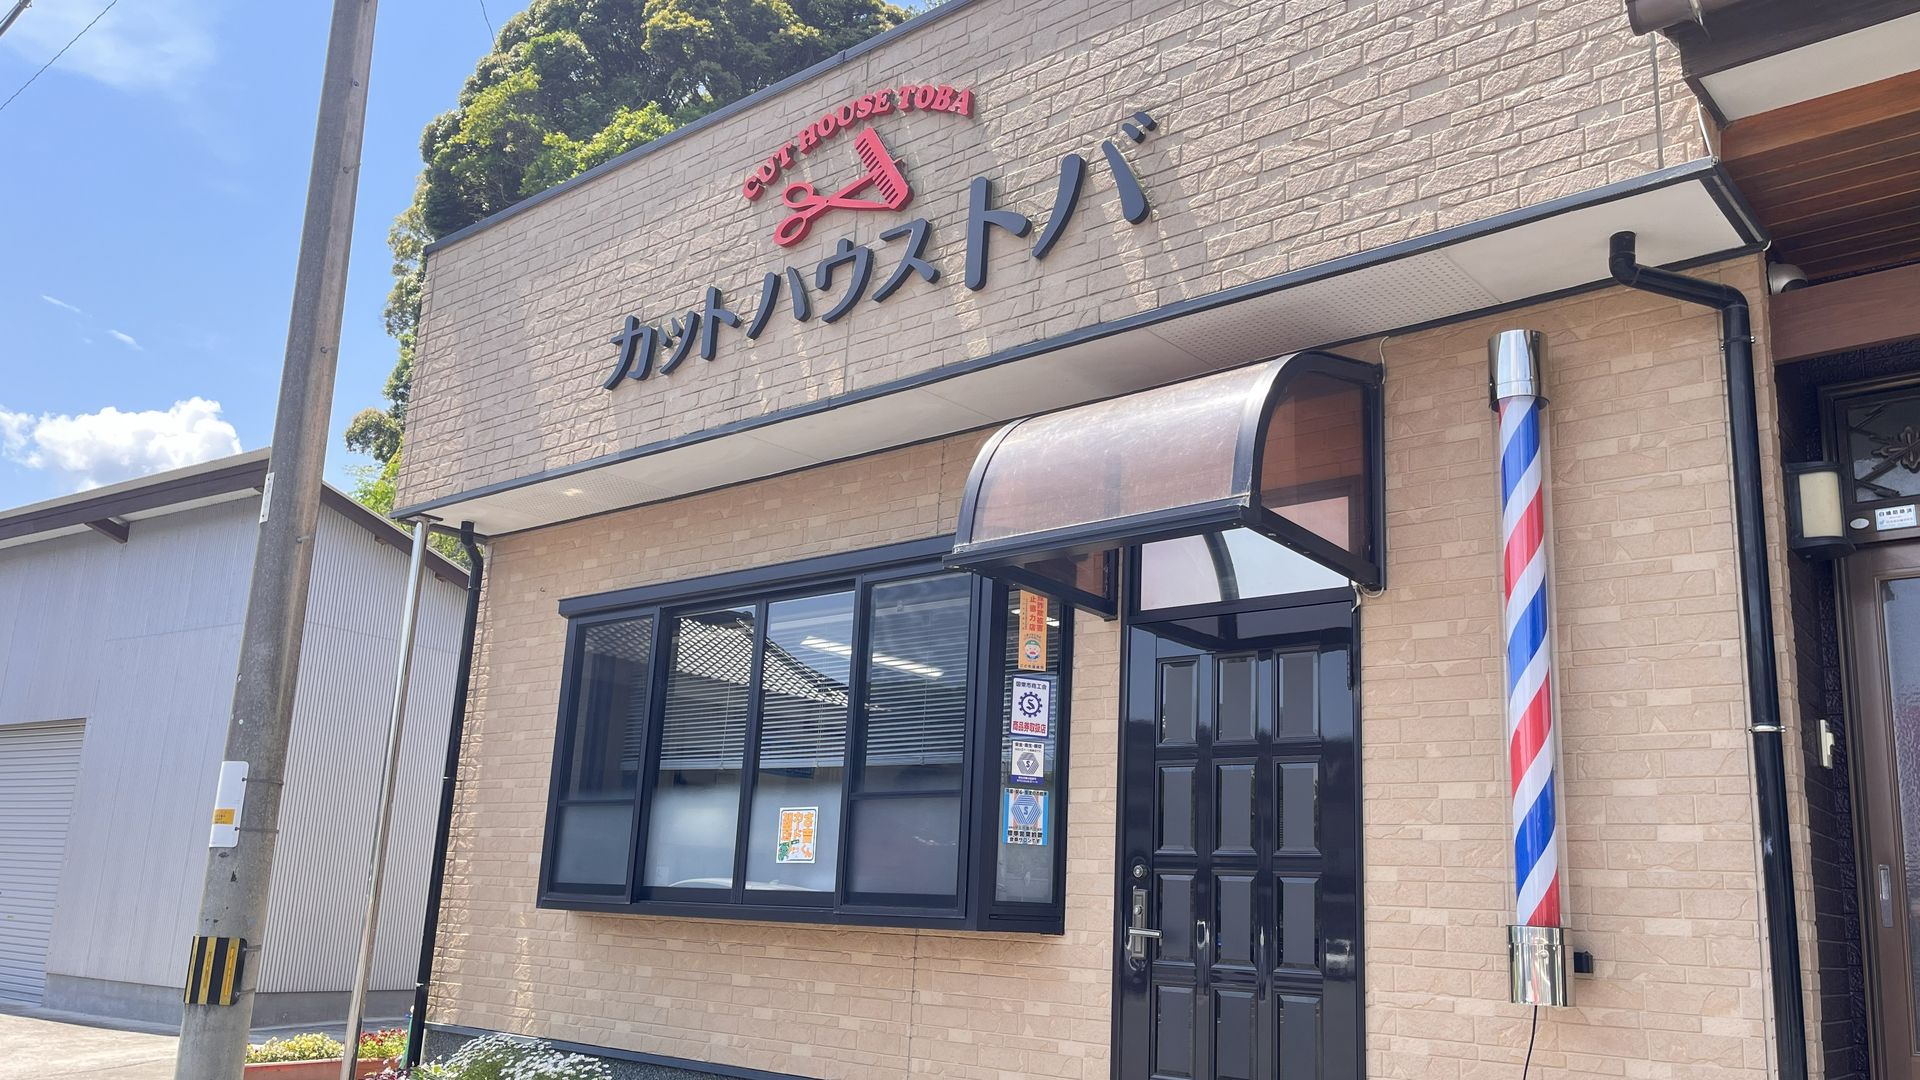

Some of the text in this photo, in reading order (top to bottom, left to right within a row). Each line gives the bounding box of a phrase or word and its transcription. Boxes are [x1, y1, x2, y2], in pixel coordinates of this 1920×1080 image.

[743, 84, 974, 200] CUT HOUSE TOBA
[1013, 720, 1047, 734] 商品券取扱店
[1023, 806, 1029, 815] S
